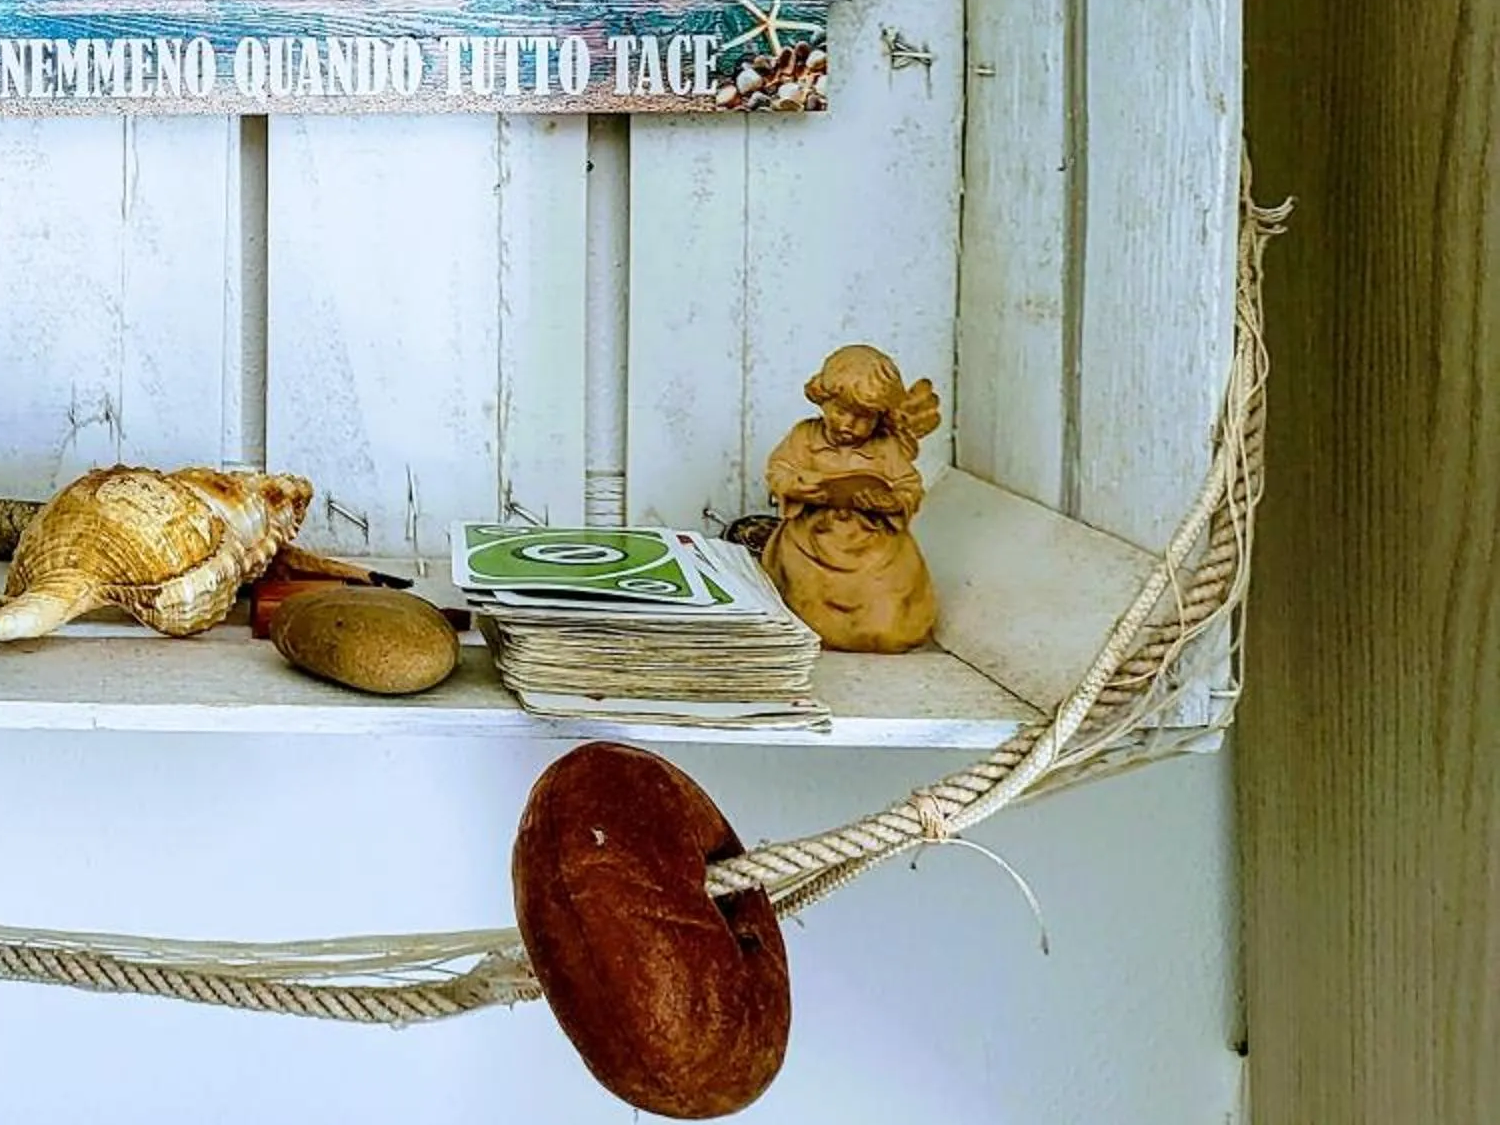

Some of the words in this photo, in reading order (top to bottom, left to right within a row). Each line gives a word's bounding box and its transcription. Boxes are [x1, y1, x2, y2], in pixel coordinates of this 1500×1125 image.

[0, 37, 216, 99] NEMMENO
[233, 36, 422, 103] QUANDO
[439, 35, 591, 97] TUTTO
[607, 34, 724, 96] TACE
